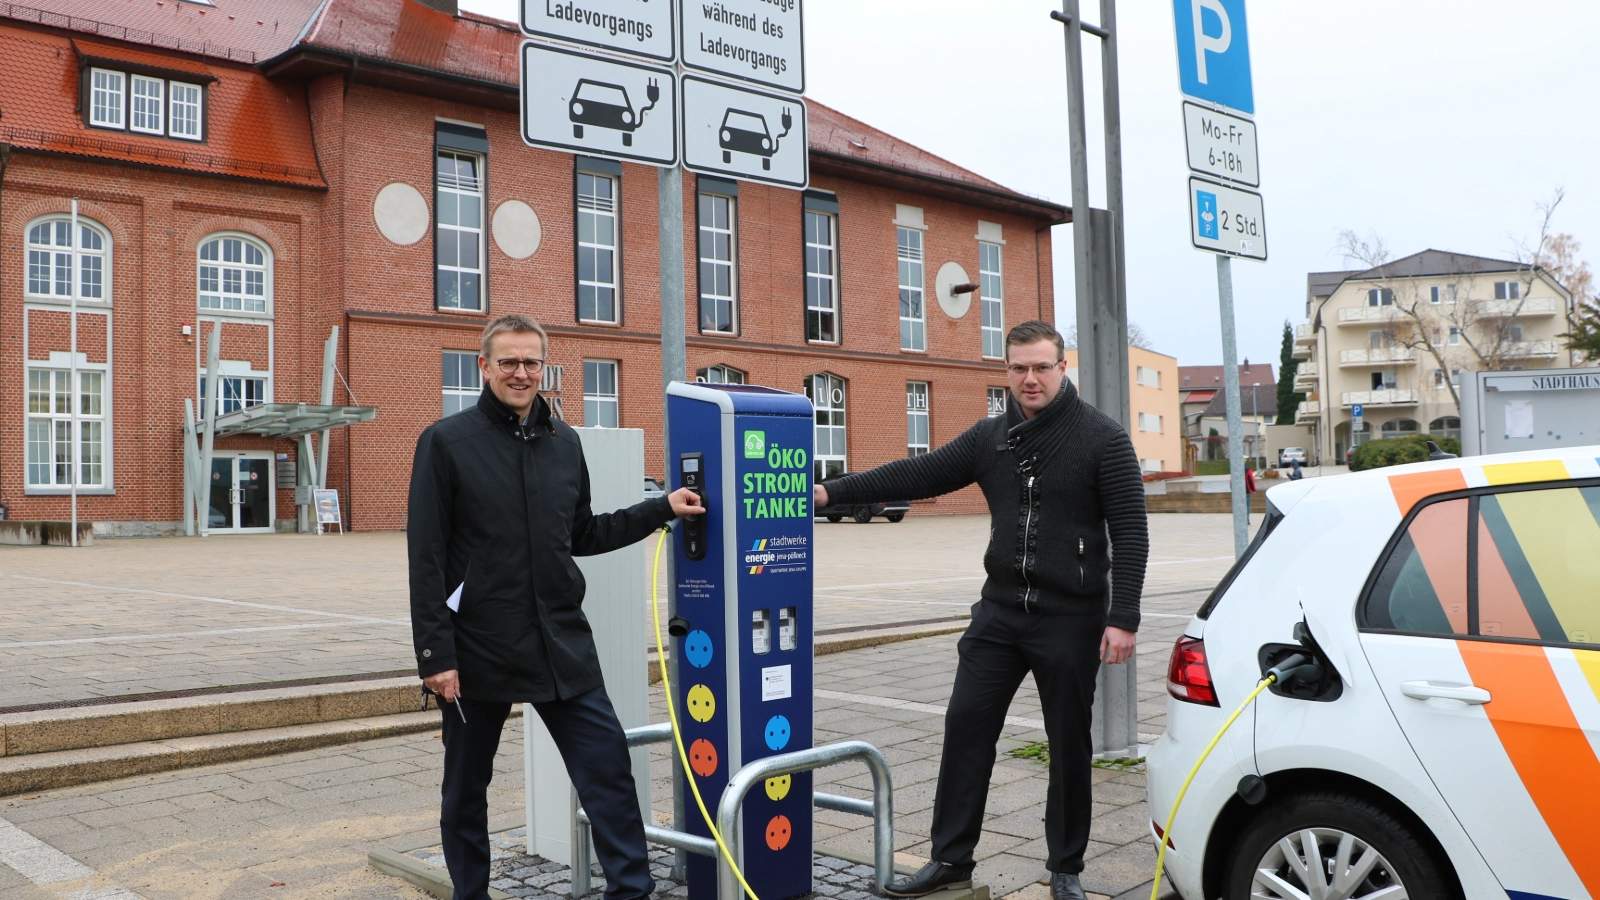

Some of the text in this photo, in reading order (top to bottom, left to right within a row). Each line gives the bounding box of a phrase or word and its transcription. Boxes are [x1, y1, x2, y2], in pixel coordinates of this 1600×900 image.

[546, 0, 653, 42] Ladevorgangs
[702, 2, 783, 39] während des
[700, 32, 787, 75] Ladevorgangs
[1191, 0, 1231, 85] P
[1201, 117, 1243, 145] Mo-Fr
[1208, 147, 1243, 173] 6-18h
[1221, 210, 1261, 238] 2 Std.
[1532, 375, 1600, 390] STADTHAUS
[1353, 405, 1361, 416] P
[768, 443, 807, 469] ÖKO
[743, 472, 807, 494] STROM
[743, 497, 808, 519] TANKE
[769, 534, 807, 547] stadtwerke
[745, 551, 776, 565] energie
